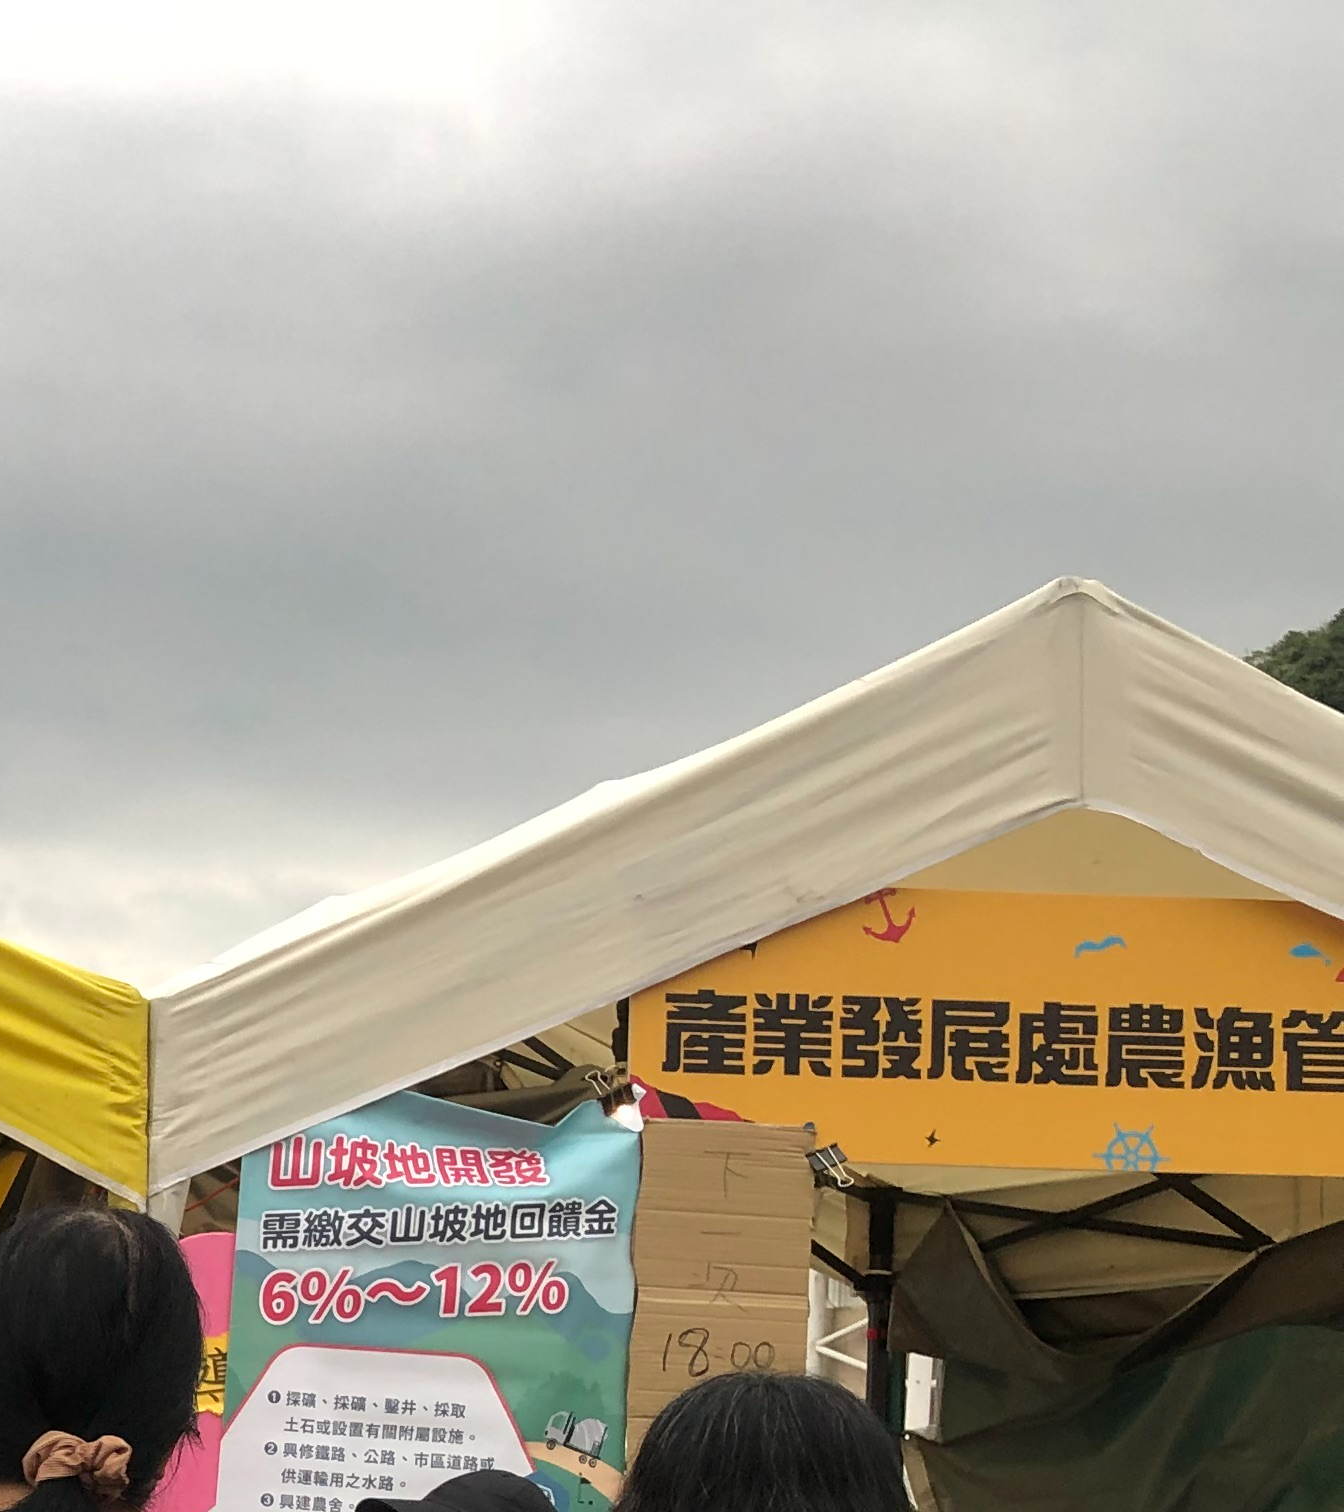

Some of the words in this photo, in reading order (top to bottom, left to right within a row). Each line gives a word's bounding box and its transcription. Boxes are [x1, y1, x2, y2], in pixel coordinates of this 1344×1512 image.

[660, 988, 1344, 1094] 產業發展處農漁管
[269, 1134, 549, 1188] 山坡地開發
[261, 1198, 618, 1251] 需繳交山坡地回饋金
[662, 1326, 776, 1378] 18:00
[283, 1416, 477, 1445] 土石或設置有關附屬設施。
[280, 1468, 407, 1492] 供運輸用之水路。
